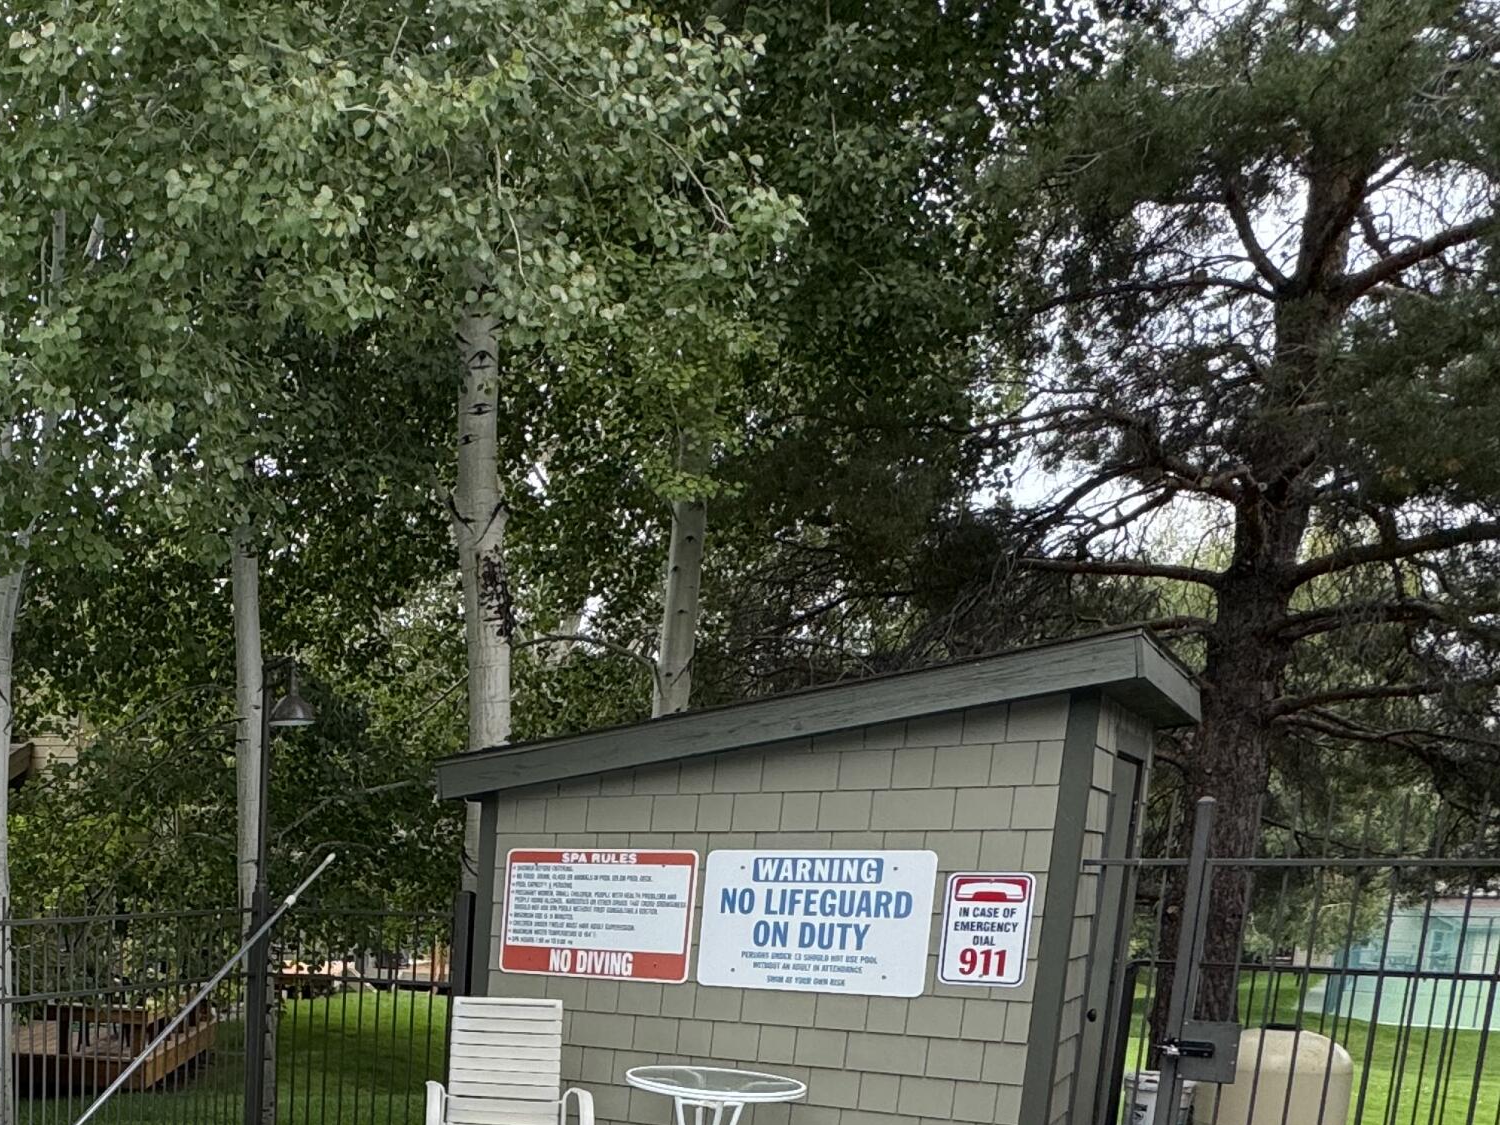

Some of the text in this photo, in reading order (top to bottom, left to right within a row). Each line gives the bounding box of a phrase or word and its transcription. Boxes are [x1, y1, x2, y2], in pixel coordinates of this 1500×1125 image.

[562, 853, 637, 863] SPA RULES
[757, 859, 878, 882] WARNING
[720, 888, 913, 919] NO LIFEGUARD
[959, 907, 1017, 918] IN CASE OF
[753, 920, 871, 950] ON DUTY
[954, 921, 1019, 933] EMERGENCY
[972, 935, 996, 946] DIAL
[549, 949, 633, 976] NO DIVING
[845, 955, 857, 963] USE
[860, 956, 877, 964] POOL
[958, 948, 1007, 977] 911
